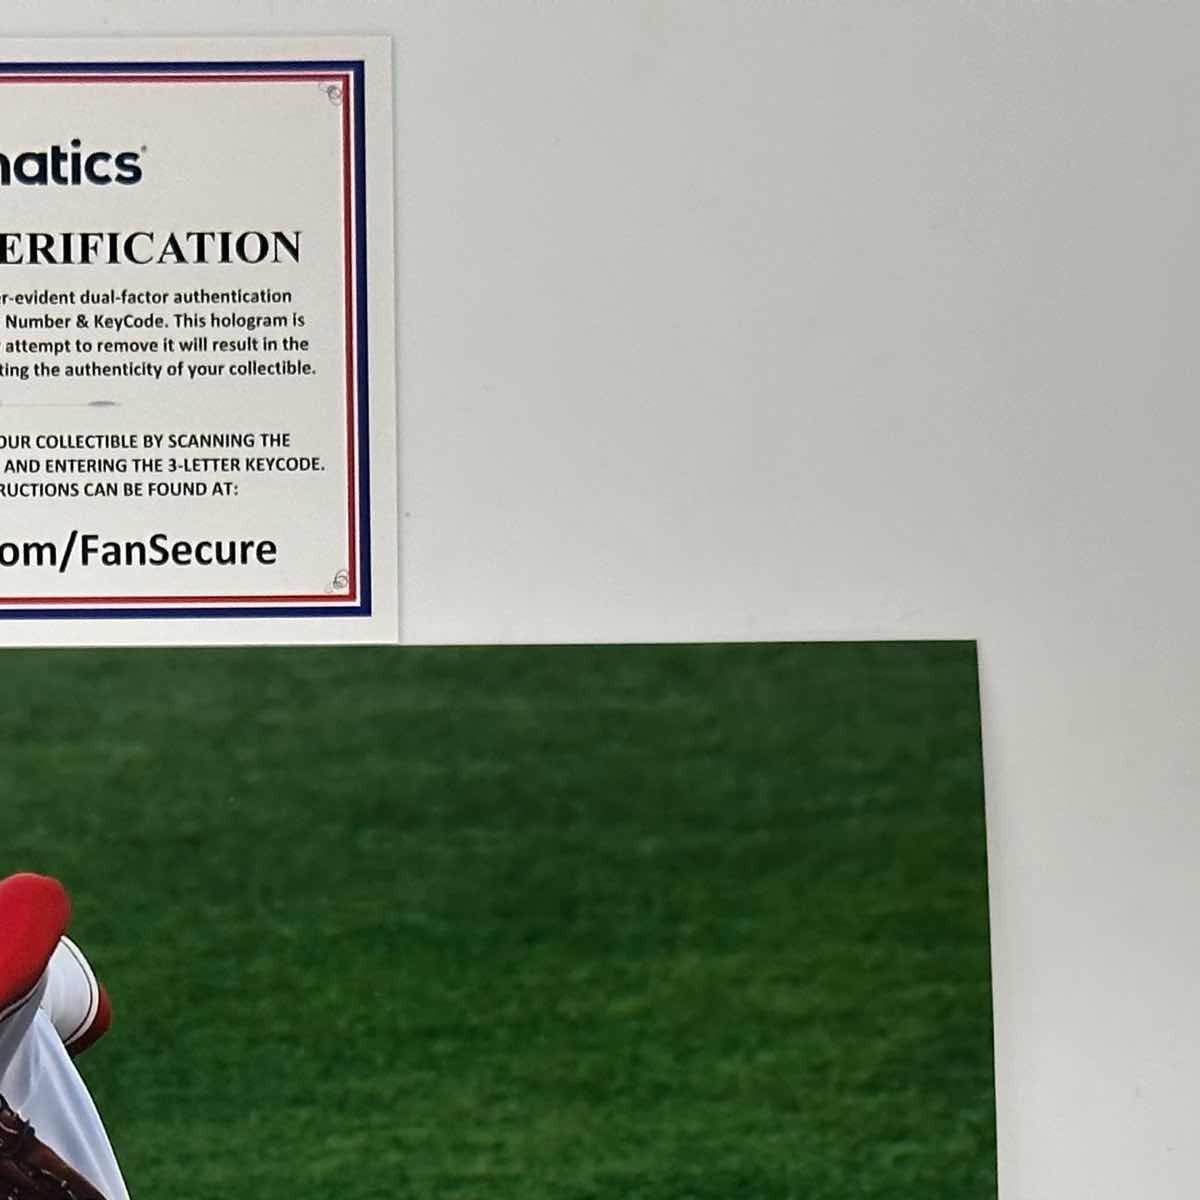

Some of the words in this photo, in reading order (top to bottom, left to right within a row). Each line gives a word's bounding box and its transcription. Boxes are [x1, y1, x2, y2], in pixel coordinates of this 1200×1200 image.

[79, 288, 169, 305] dual-factor
[173, 288, 292, 304] authentication
[5, 313, 72, 329] Number
[75, 313, 89, 329] &
[94, 312, 169, 332] KeyCode.
[173, 312, 207, 329] This
[210, 312, 288, 331] hologram
[292, 312, 305, 328] is
[5, 339, 71, 356] attempt
[75, 339, 93, 353] to
[97, 341, 159, 353] remove
[163, 337, 175, 353] it
[178, 336, 208, 352] will
[212, 336, 259, 352] result
[263, 336, 278, 352] in
[282, 335, 309, 351] the
[33, 361, 61, 377] the
[64, 361, 163, 380] authenticity
[166, 360, 184, 377] of
[187, 364, 225, 380] your
[229, 359, 316, 376] collectible.
[35, 434, 138, 449] COLLECTIBLE
[143, 434, 164, 449] BY
[168, 433, 255, 449] SCANNING
[260, 432, 291, 448] THE
[3, 459, 41, 474] AND
[45, 458, 128, 474] ENTERING
[131, 458, 163, 473] THE
[168, 457, 241, 473] 3-LETTER
[245, 457, 325, 472] KEYCODE.
[83, 482, 118, 497] CAN
[123, 482, 143, 497] BE
[148, 482, 208, 497] FOUND
[211, 481, 239, 496] AT:
